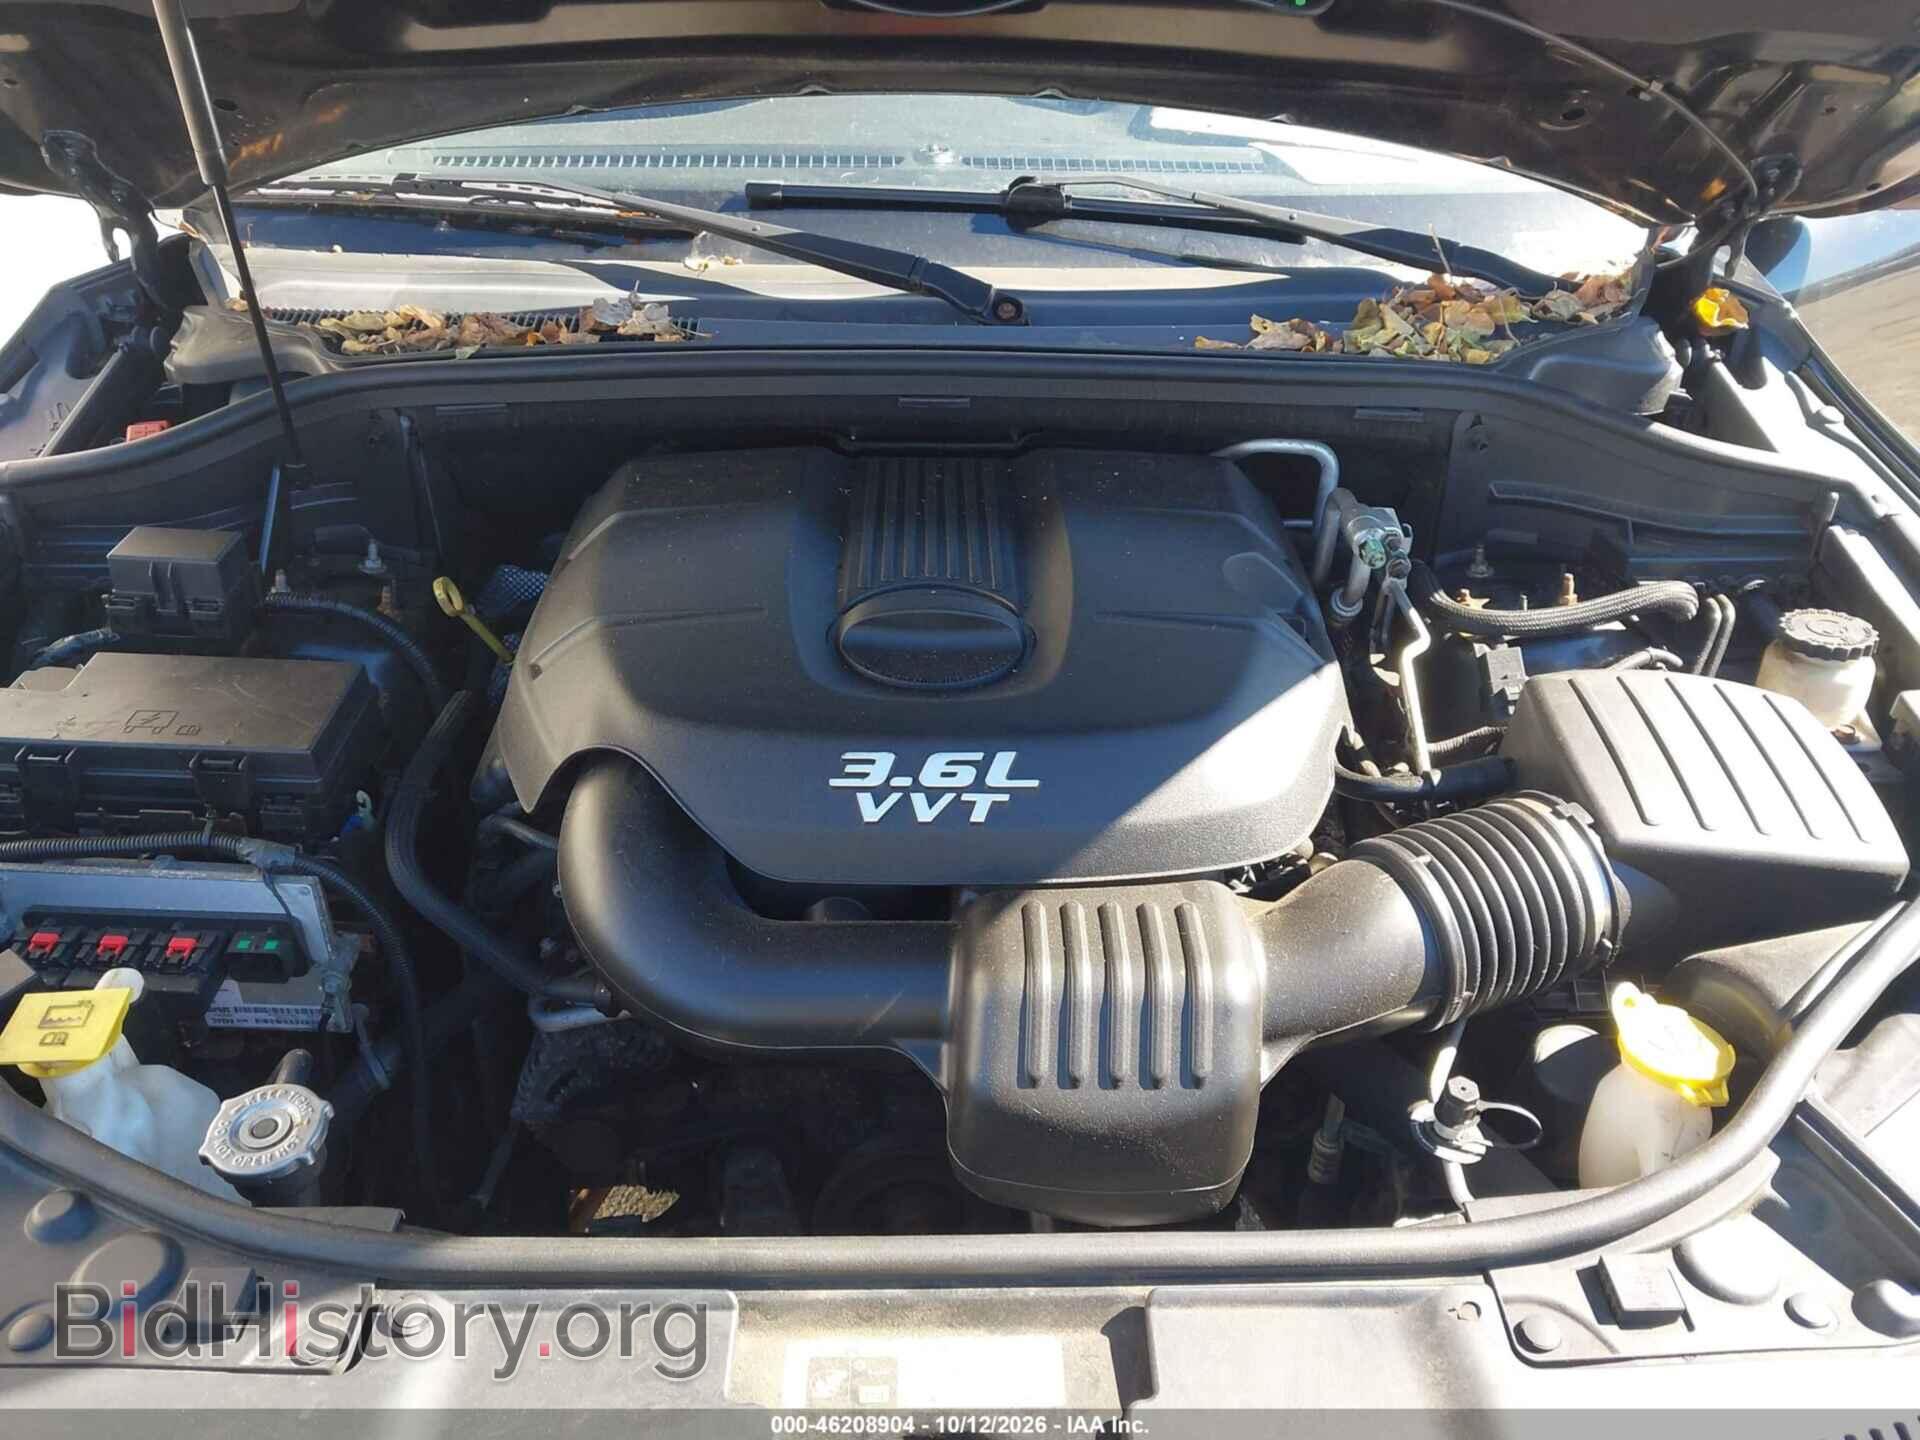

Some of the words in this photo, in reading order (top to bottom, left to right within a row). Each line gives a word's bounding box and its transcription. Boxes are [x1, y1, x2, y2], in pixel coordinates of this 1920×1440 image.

[828, 751, 1041, 789] 3.6L
[855, 792, 1011, 824] VVT
[213, 1138, 238, 1160] NOT
[232, 1153, 273, 1168] OPEN
[275, 1134, 300, 1158] HOT
